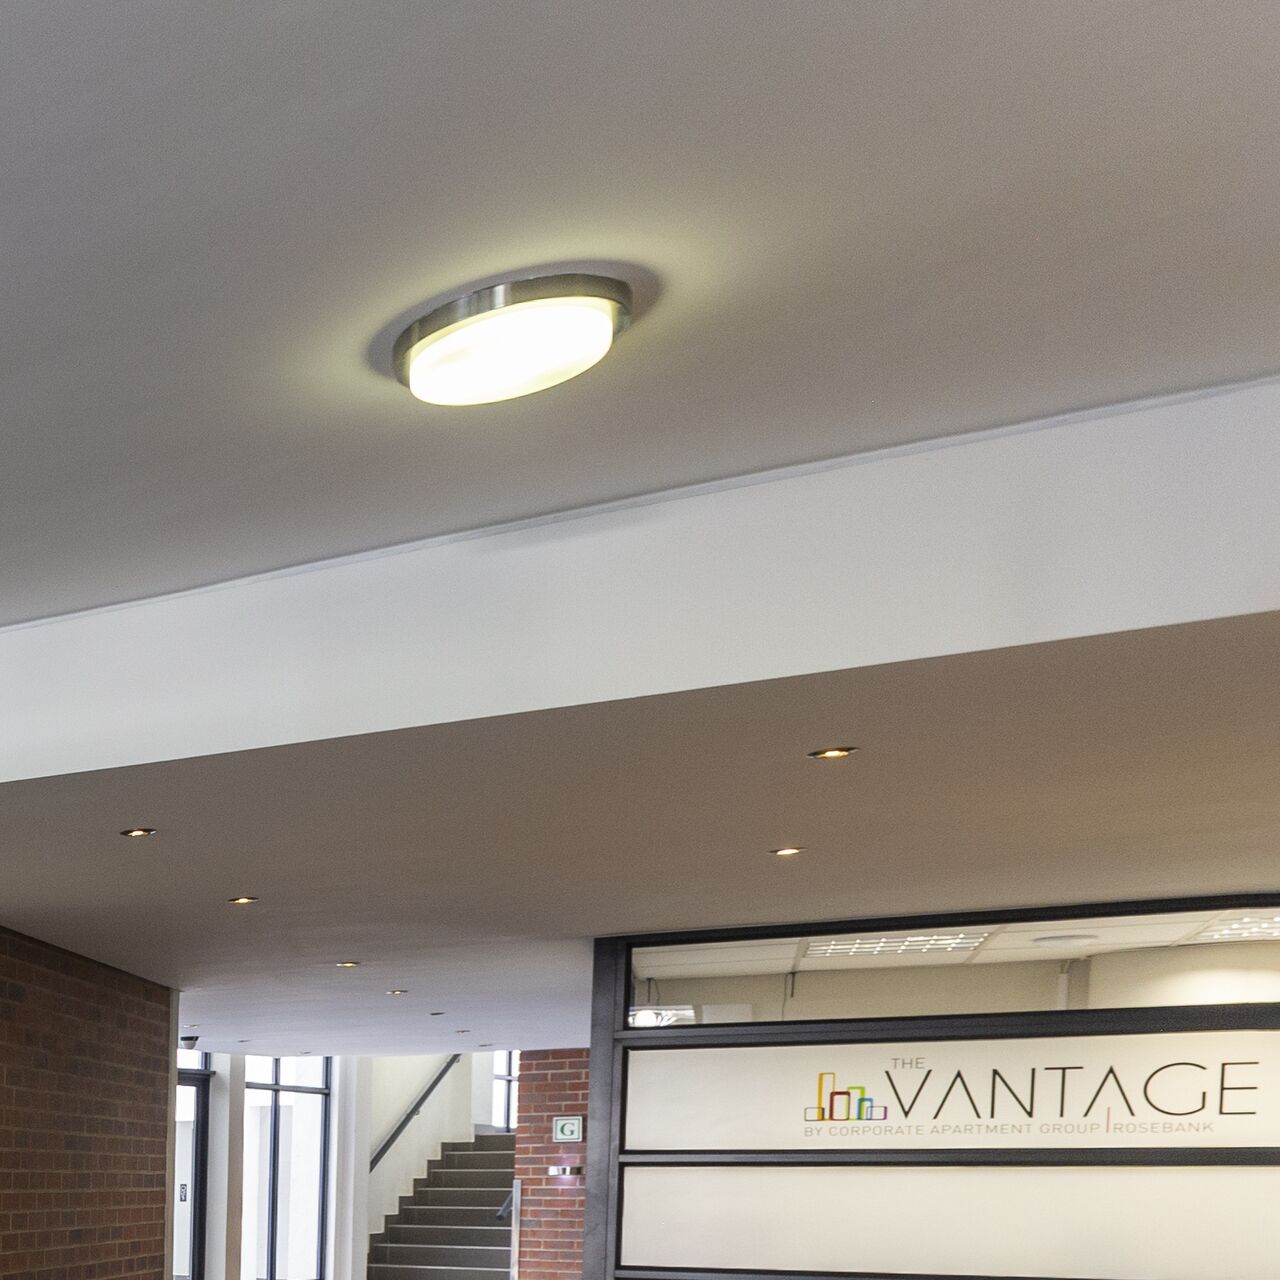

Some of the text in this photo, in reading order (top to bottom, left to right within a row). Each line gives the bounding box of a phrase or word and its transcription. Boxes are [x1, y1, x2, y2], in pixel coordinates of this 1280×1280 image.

[891, 1057, 926, 1070] THE
[885, 1061, 1259, 1119] VANTAGE
[560, 1122, 575, 1136] G
[803, 1122, 1214, 1136] BY CORPORATE APARTMENT GROUP ROSEBANK
